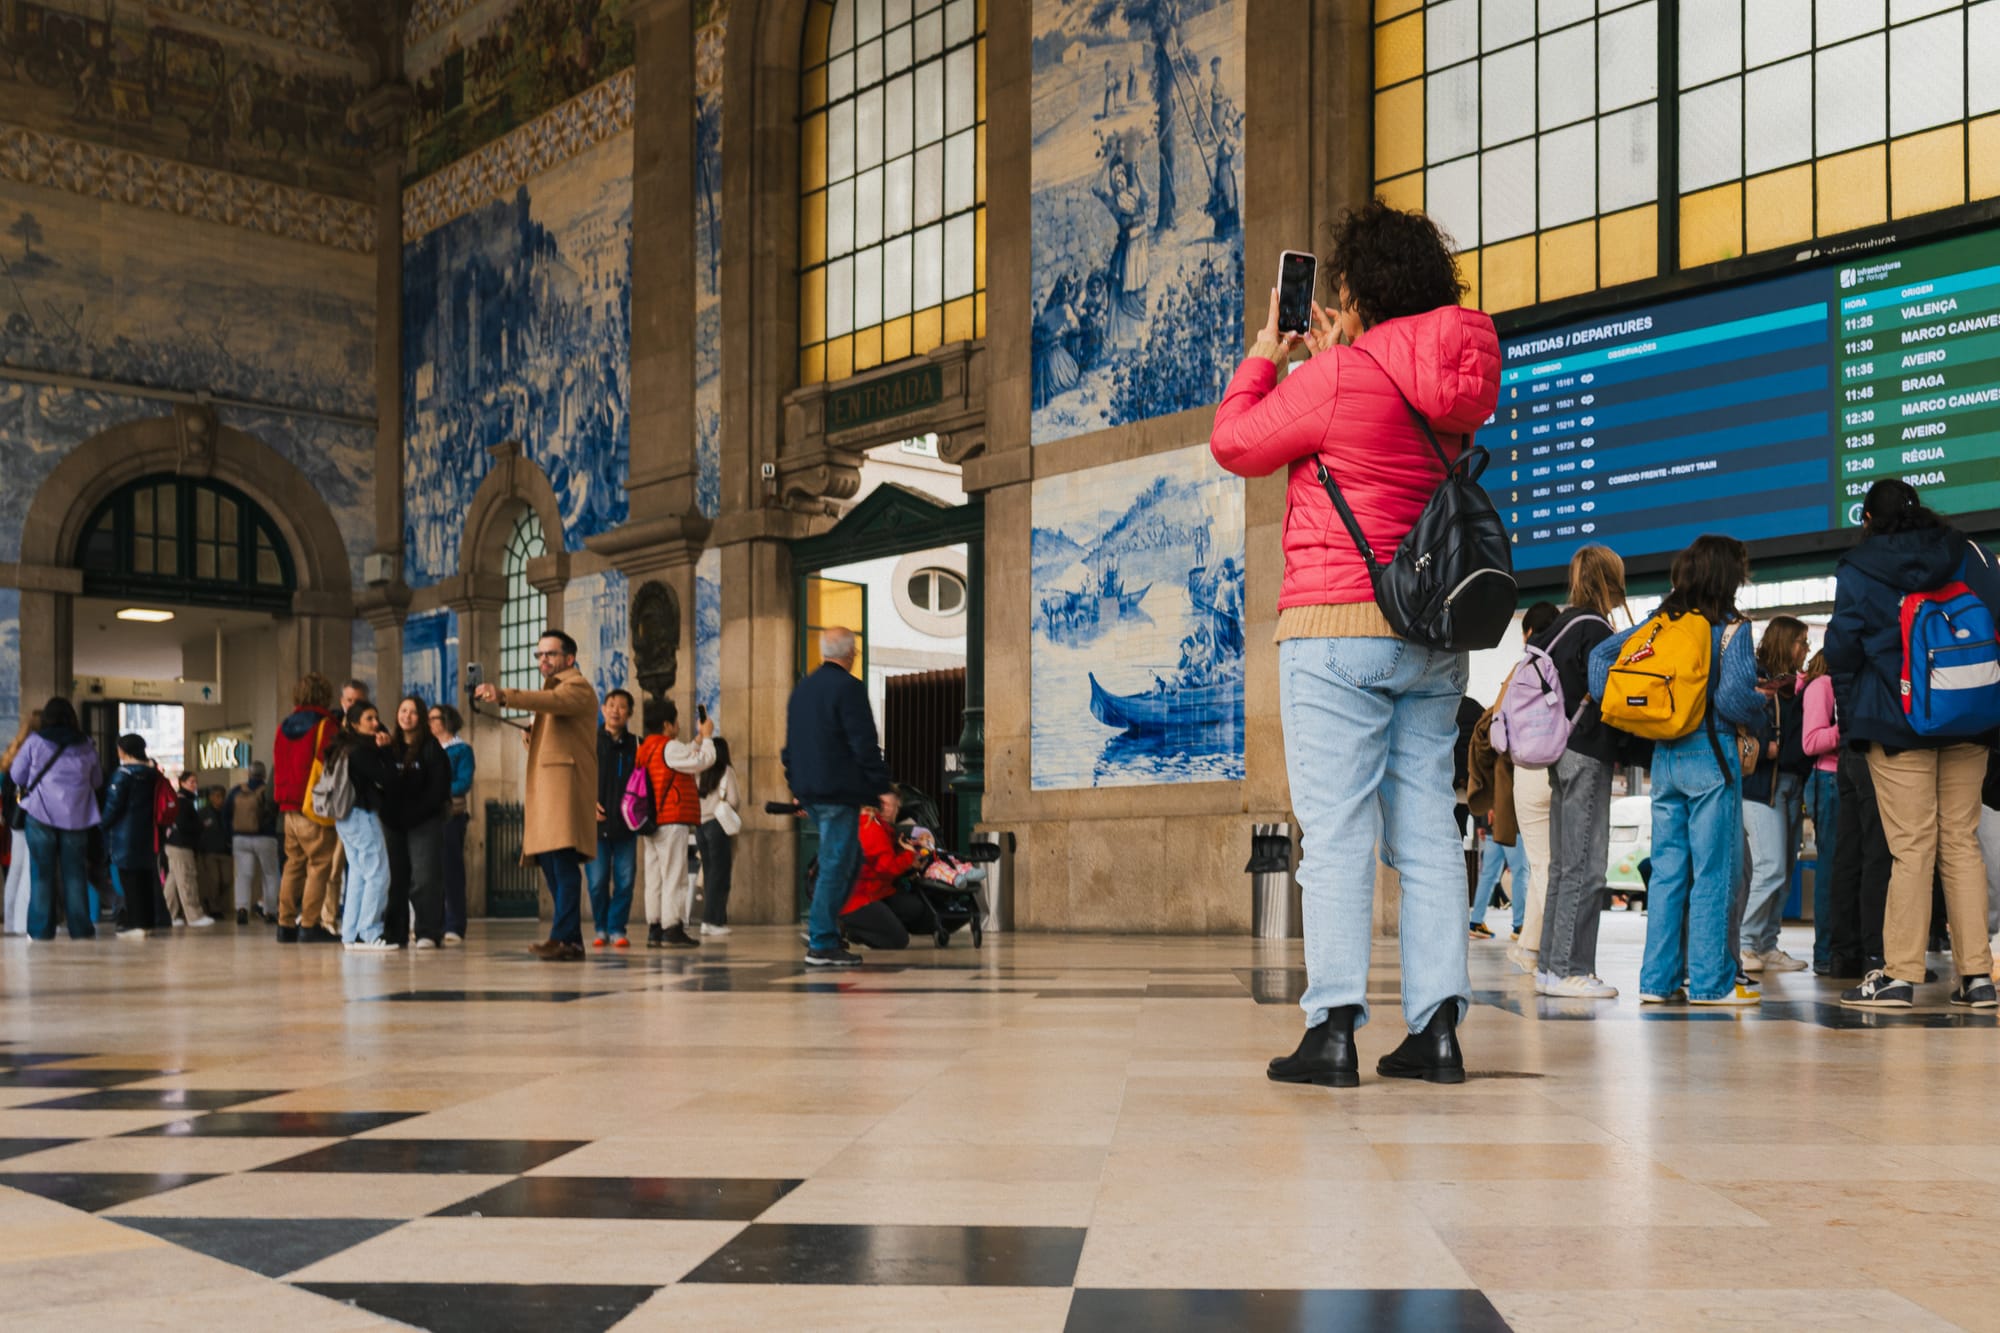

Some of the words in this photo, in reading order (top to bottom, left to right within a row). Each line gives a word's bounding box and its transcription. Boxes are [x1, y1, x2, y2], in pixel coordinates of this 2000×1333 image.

[1845, 298, 1867, 310] HORA
[1901, 283, 1933, 298] ORIGEM
[1845, 314, 1873, 331] 11:25
[1901, 298, 1957, 320] VALENÇA
[1508, 335, 1564, 360] PARTIDAS
[1572, 316, 1653, 345] DEPARTURES
[1845, 338, 1874, 355] 11:30
[1901, 324, 1946, 344] MARCO
[1845, 362, 1874, 379] 11:35
[1901, 349, 1946, 368] AVEIRO
[834, 371, 934, 425] ENTRADA
[1845, 386, 1874, 402] 11:45
[1901, 373, 1945, 392] BRAGA
[1845, 410, 1874, 425] 12:30
[1901, 398, 1946, 416] MARCO
[1845, 433, 1875, 449] 12:35
[1901, 422, 1947, 440] AVEIRO
[1671, 463, 1696, 475] FRONT
[1695, 460, 1717, 471] TRAIN
[1845, 457, 1875, 473] 12:40
[1902, 446, 1945, 465] RÉGUA
[1902, 470, 1946, 487] BRAGA
